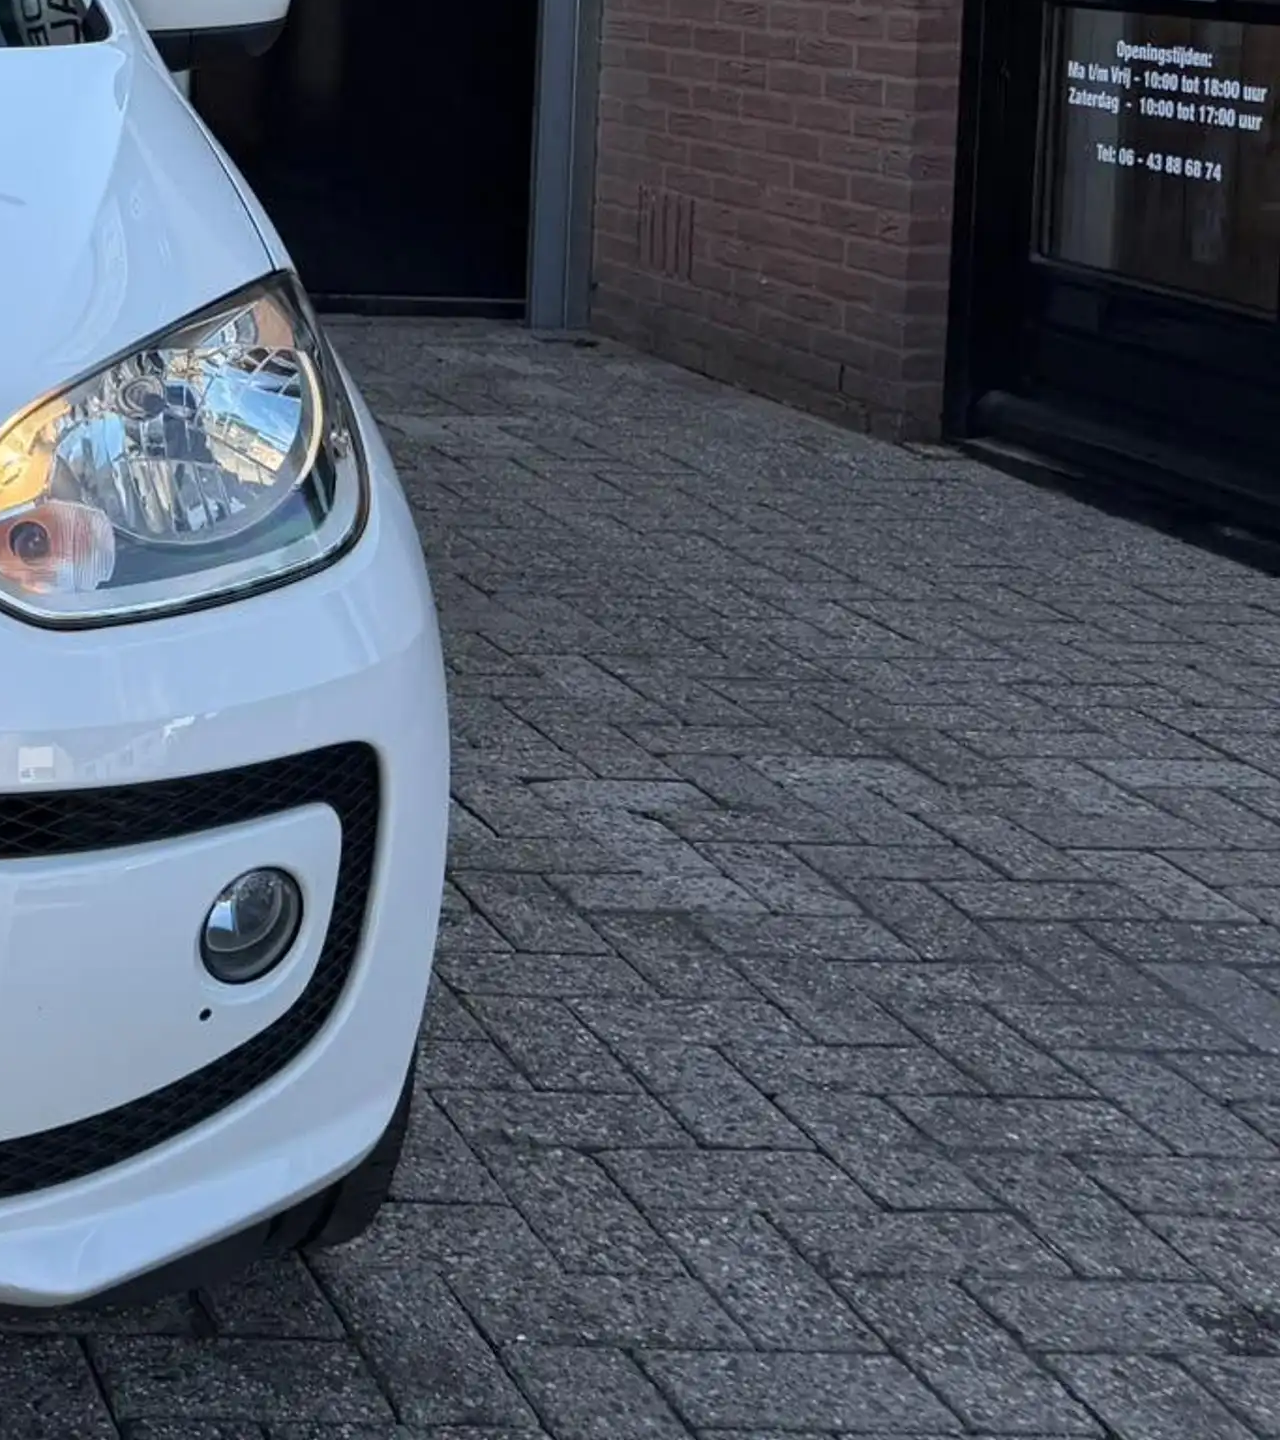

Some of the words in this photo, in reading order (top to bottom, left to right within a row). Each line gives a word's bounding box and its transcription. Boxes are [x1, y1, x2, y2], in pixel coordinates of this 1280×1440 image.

[1116, 40, 1213, 68] Openingstijden:
[1067, 61, 1085, 80] Ma
[1111, 66, 1132, 89] Vrij
[1144, 71, 1178, 92] 10:00
[1181, 76, 1200, 95] tot
[1203, 78, 1240, 99] 18:00
[1243, 85, 1269, 103] uur
[1068, 87, 1120, 114] Zaterdag
[1140, 97, 1174, 118] 10:00
[1177, 102, 1195, 122] tot
[1199, 105, 1236, 127] 17:00
[1238, 113, 1263, 131] uur
[1096, 143, 1116, 163] Tel:
[1118, 148, 1135, 166] 06
[1146, 152, 1163, 171] 43
[1205, 162, 1222, 182] 74
